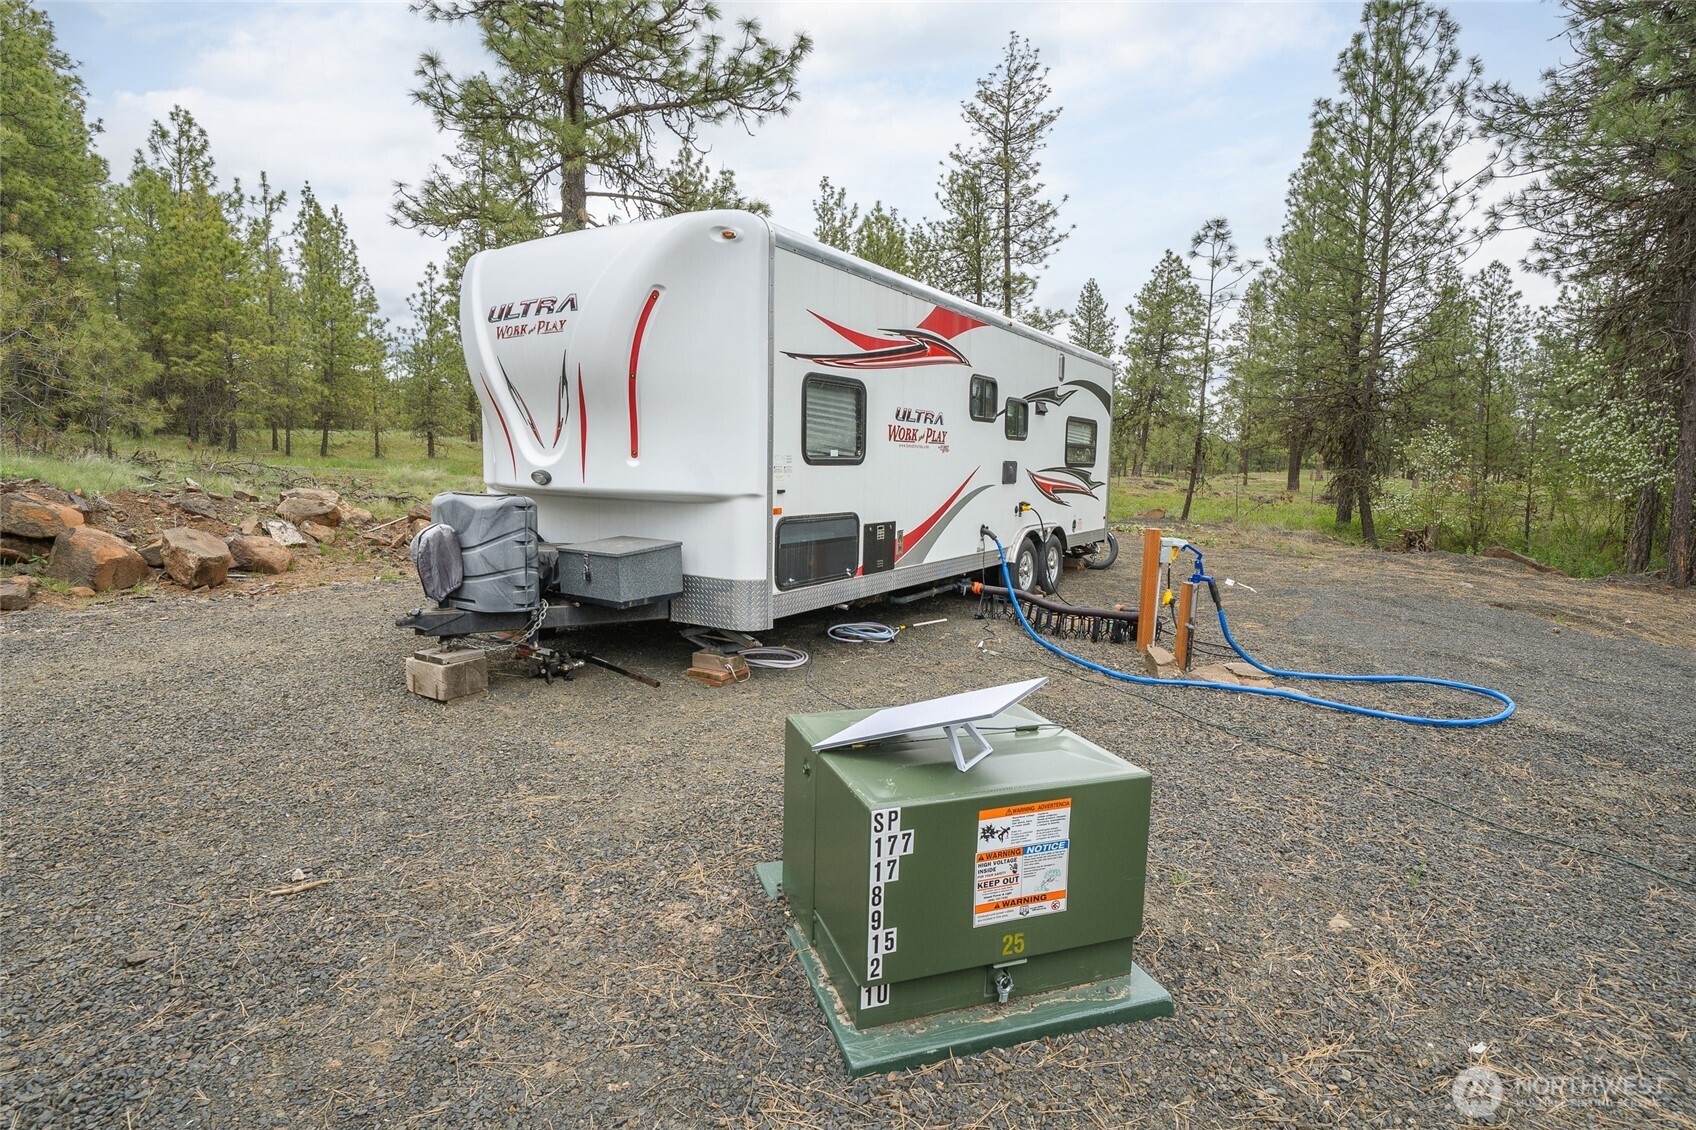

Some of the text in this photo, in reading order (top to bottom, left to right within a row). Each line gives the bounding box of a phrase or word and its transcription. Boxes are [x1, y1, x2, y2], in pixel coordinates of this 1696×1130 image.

[488, 293, 578, 323] ULTRA
[496, 324, 528, 340] WORK
[537, 320, 567, 335] PLAY
[895, 407, 944, 425] ULTRA
[888, 424, 919, 442] WORK
[925, 427, 948, 444] PLAY
[1012, 805, 1036, 814] WARNING
[873, 809, 899, 833] SP
[874, 831, 912, 858] 177
[986, 848, 1021, 860] WARNING
[1026, 841, 1066, 854] NOTICE
[873, 858, 897, 882] 17
[977, 861, 992, 869] HIGH
[993, 857, 1018, 866] VOLTAGE
[977, 867, 996, 875] INSIDE
[977, 876, 1020, 889] KEEP OUT
[871, 885, 882, 907] 8
[1002, 894, 1047, 908] WARNING
[871, 909, 882, 931] 9
[872, 930, 895, 954] 15
[1002, 932, 1025, 955] 25
[870, 957, 880, 978] 2
